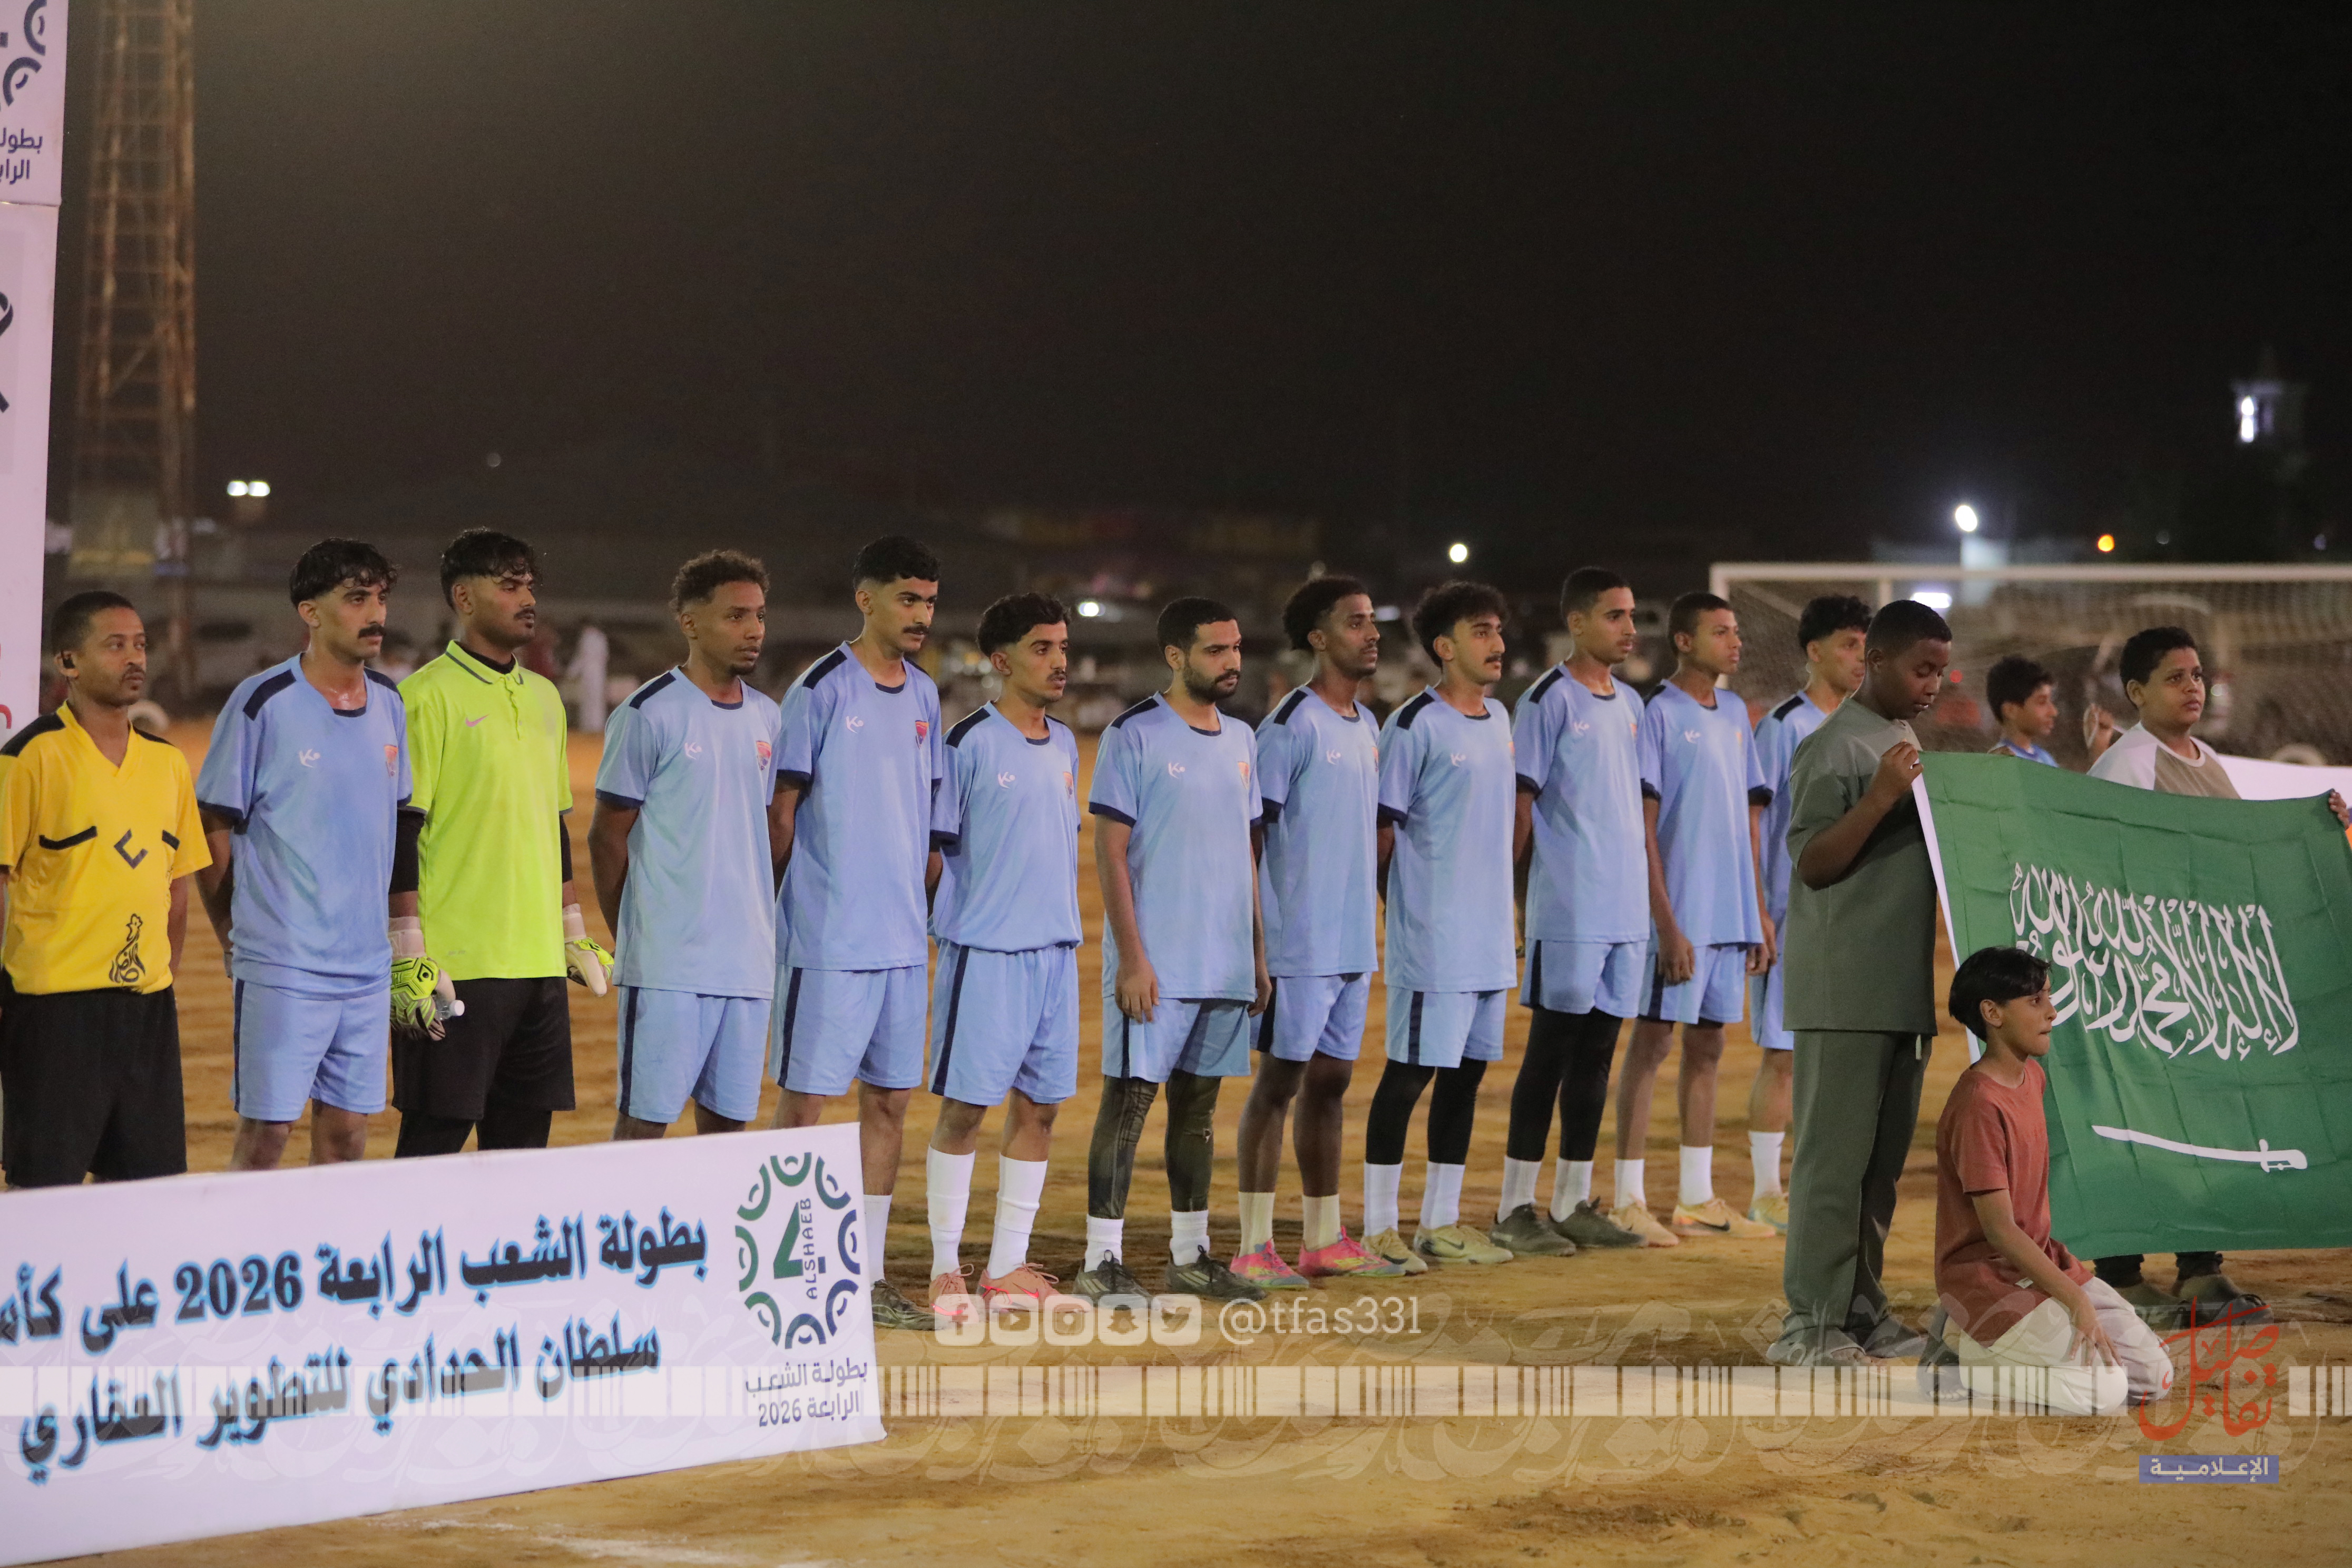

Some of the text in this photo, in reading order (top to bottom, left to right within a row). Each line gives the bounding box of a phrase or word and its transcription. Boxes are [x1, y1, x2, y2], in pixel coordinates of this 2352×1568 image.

[0, 128, 43, 154] بطول
[173, 1250, 305, 1325] 2026
[314, 1223, 448, 1320] الرابعة
[459, 1210, 587, 1308] الشعب
[597, 1206, 708, 1289] بطولة
[800, 1198, 818, 1300] ALSHAEB
[80, 1257, 160, 1356] على
[19, 1308, 661, 1486] سلطان الحدادي للتطوير العقاري
[746, 1357, 867, 1398] بطولة الشعب
[759, 1390, 859, 1427] الرابعة 2026
